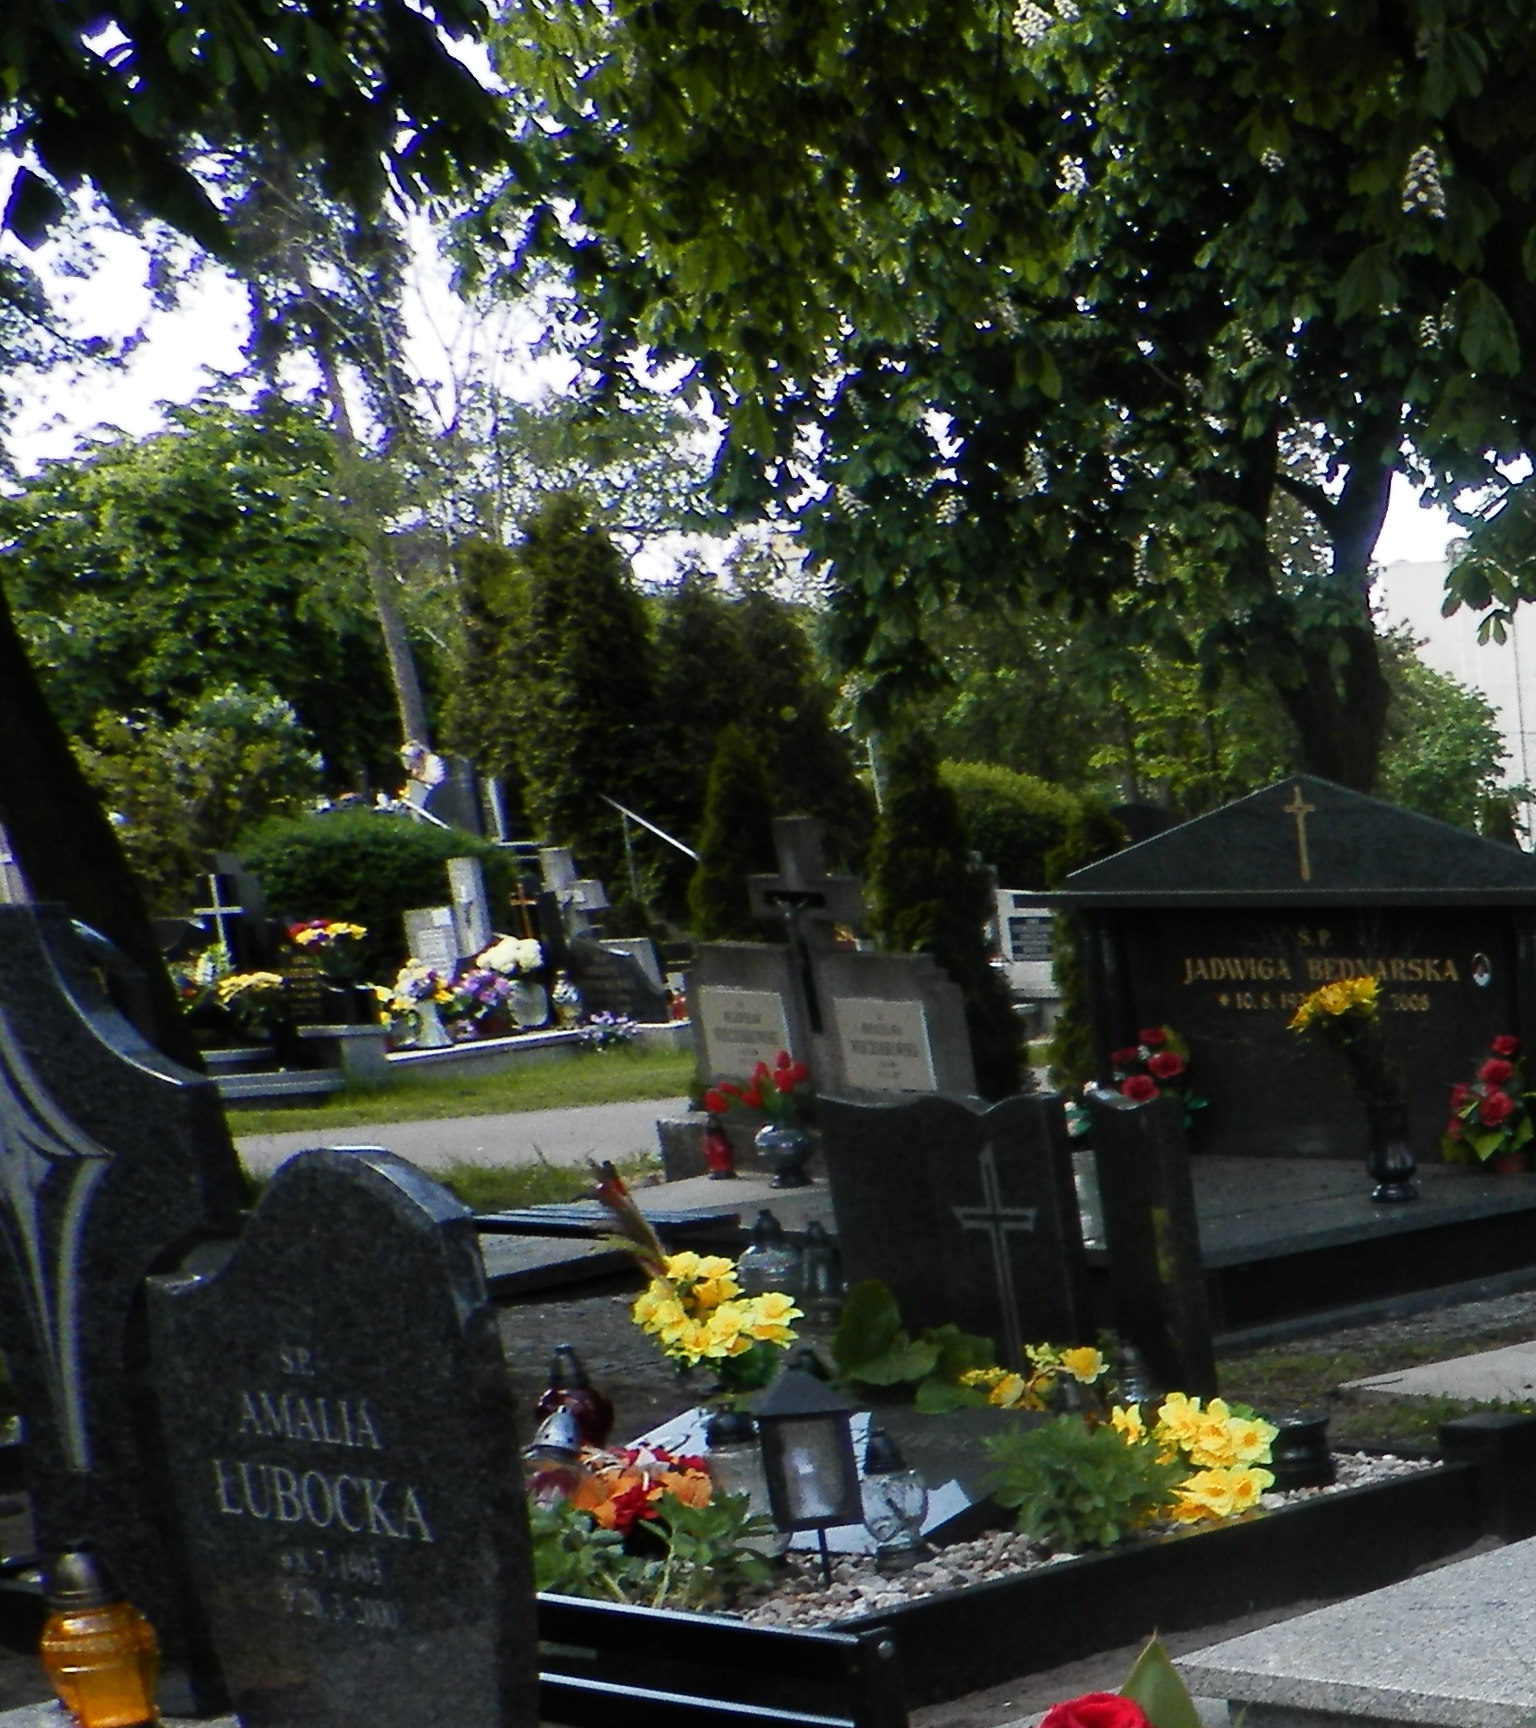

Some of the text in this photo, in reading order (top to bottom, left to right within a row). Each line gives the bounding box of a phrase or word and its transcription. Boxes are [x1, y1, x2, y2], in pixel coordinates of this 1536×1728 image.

[1184, 958, 1459, 984] JADWIGA BEDNARSKA
[240, 1392, 382, 1450] AMALIA
